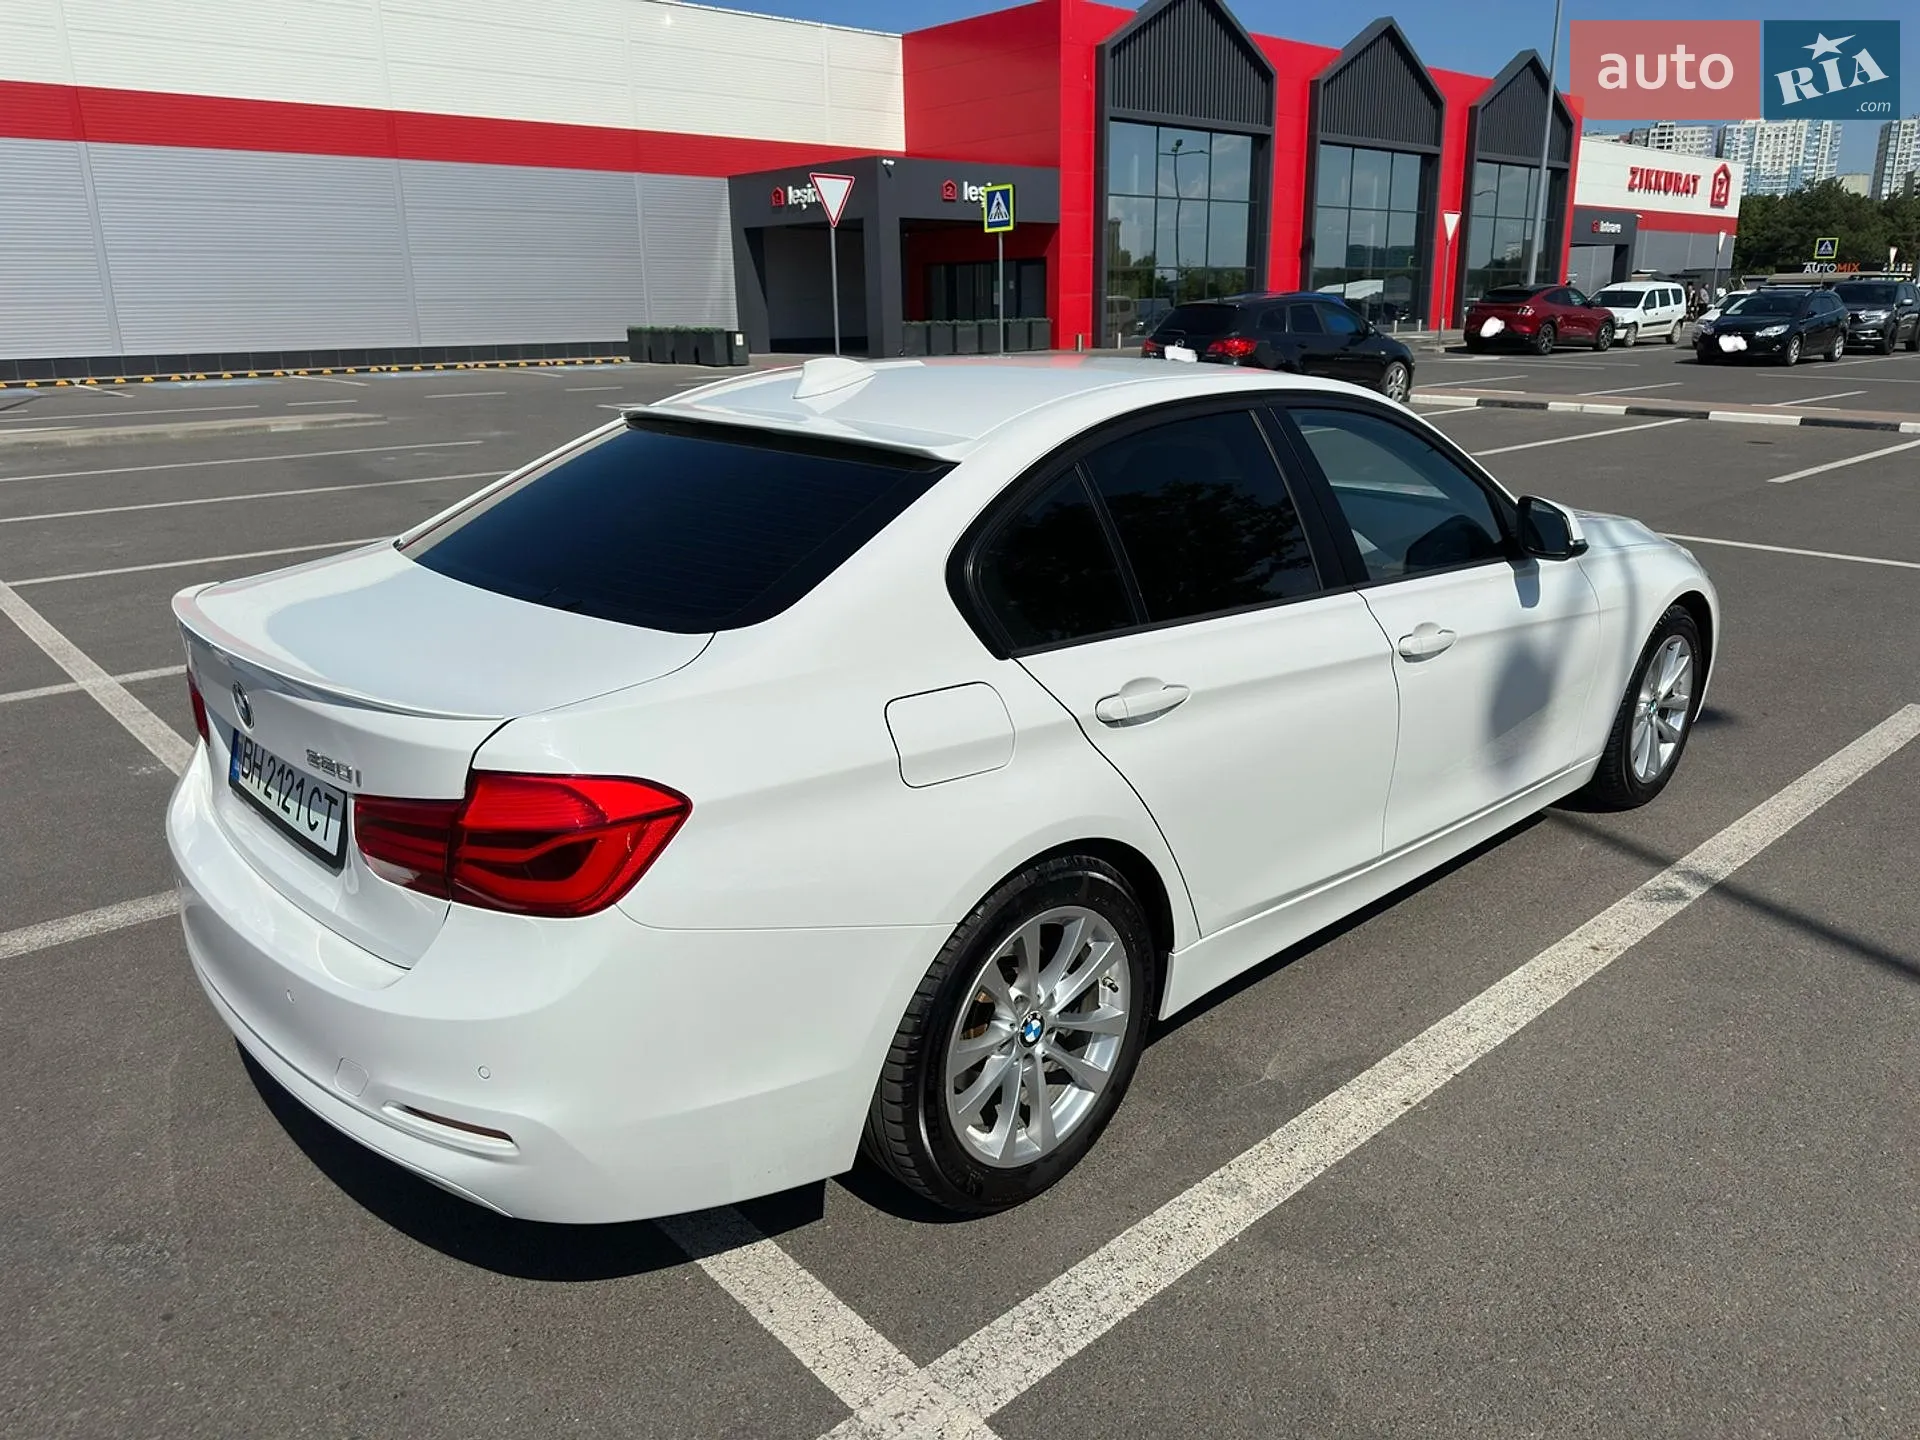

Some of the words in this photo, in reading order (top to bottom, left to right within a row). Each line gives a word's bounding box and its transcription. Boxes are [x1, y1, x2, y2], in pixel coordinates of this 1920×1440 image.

[1628, 166, 1702, 198] ZIKKURAT
[241, 736, 265, 790] BH
[264, 758, 305, 822] 2121
[306, 787, 339, 841] CT
